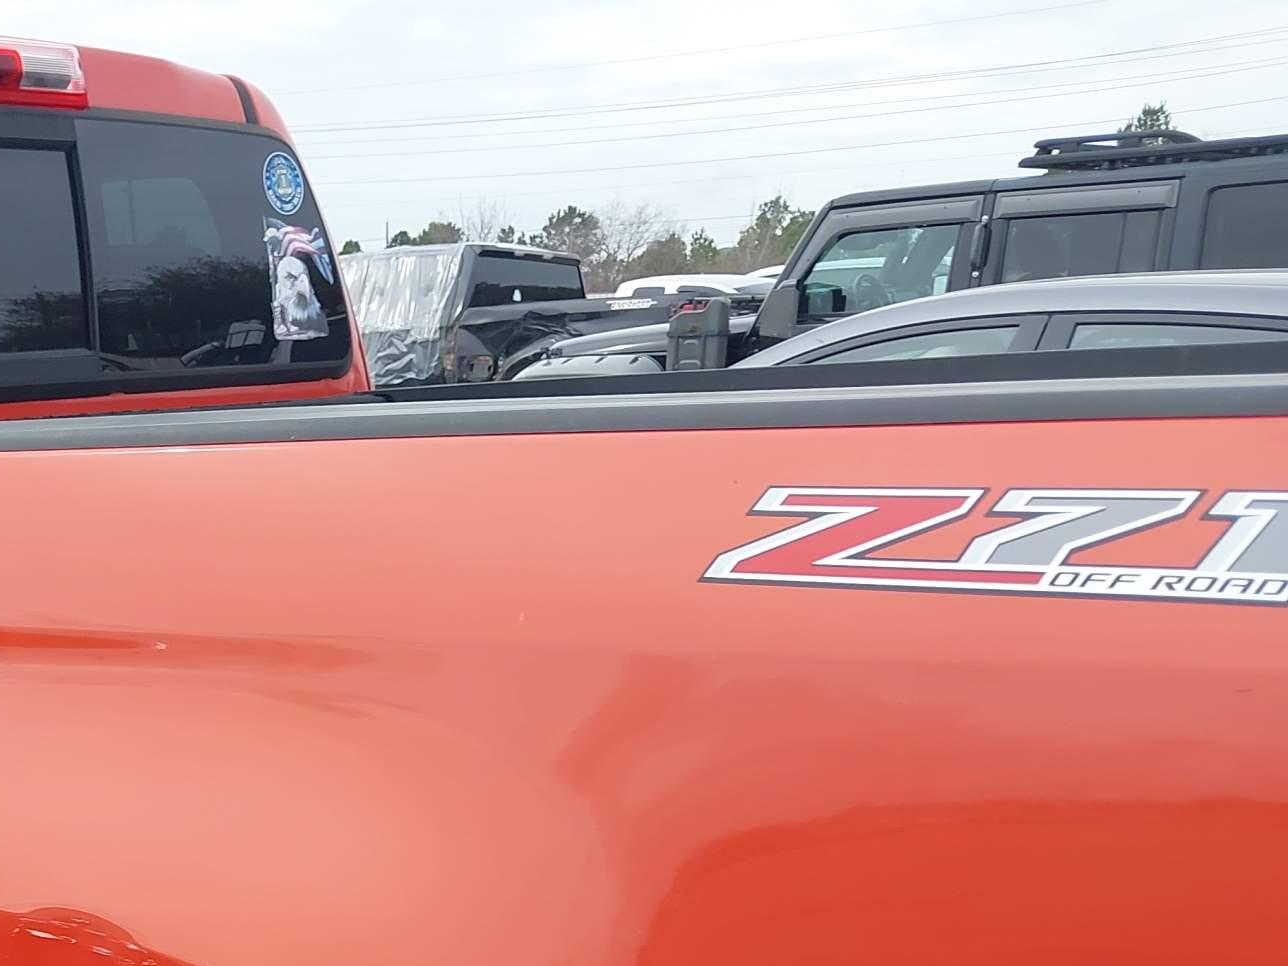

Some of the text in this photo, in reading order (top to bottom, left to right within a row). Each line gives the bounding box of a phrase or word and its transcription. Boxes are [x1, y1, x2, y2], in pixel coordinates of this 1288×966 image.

[698, 485, 1288, 606] Z71
[1049, 571, 1288, 596] OFF ROAD
